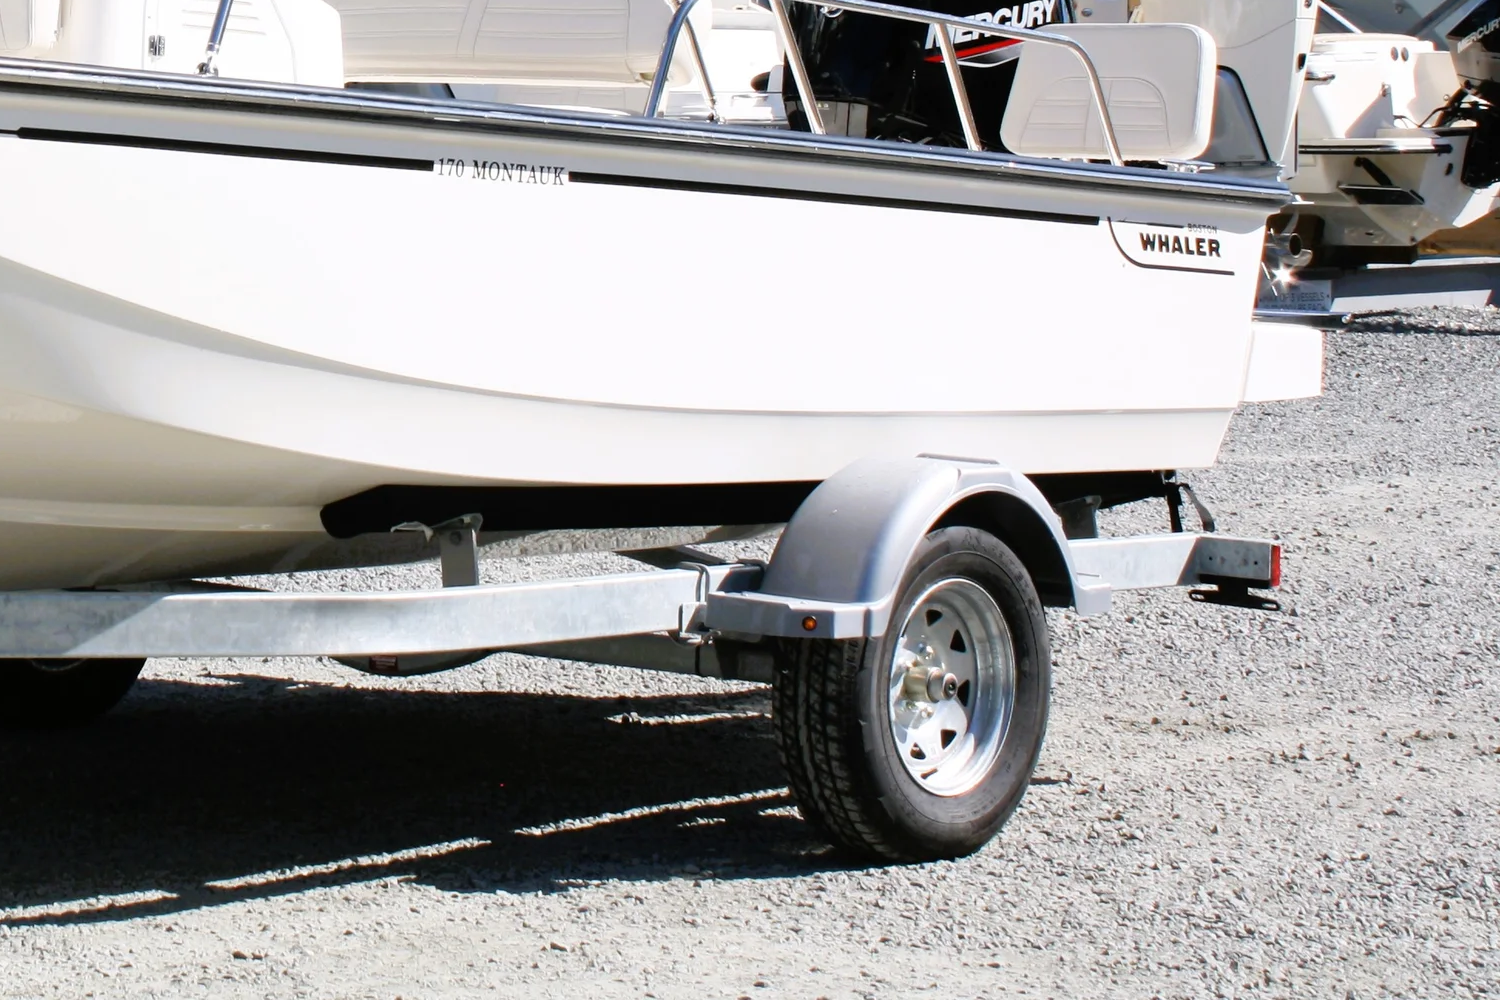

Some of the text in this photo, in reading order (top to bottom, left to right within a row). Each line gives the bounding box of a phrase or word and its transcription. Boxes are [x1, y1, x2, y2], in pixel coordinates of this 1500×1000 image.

[1457, 16, 1500, 54] MERCUR
[438, 158, 565, 186] 170 MONTAUK
[1187, 223, 1218, 235] BOSTON
[1139, 232, 1221, 258] WHALER
